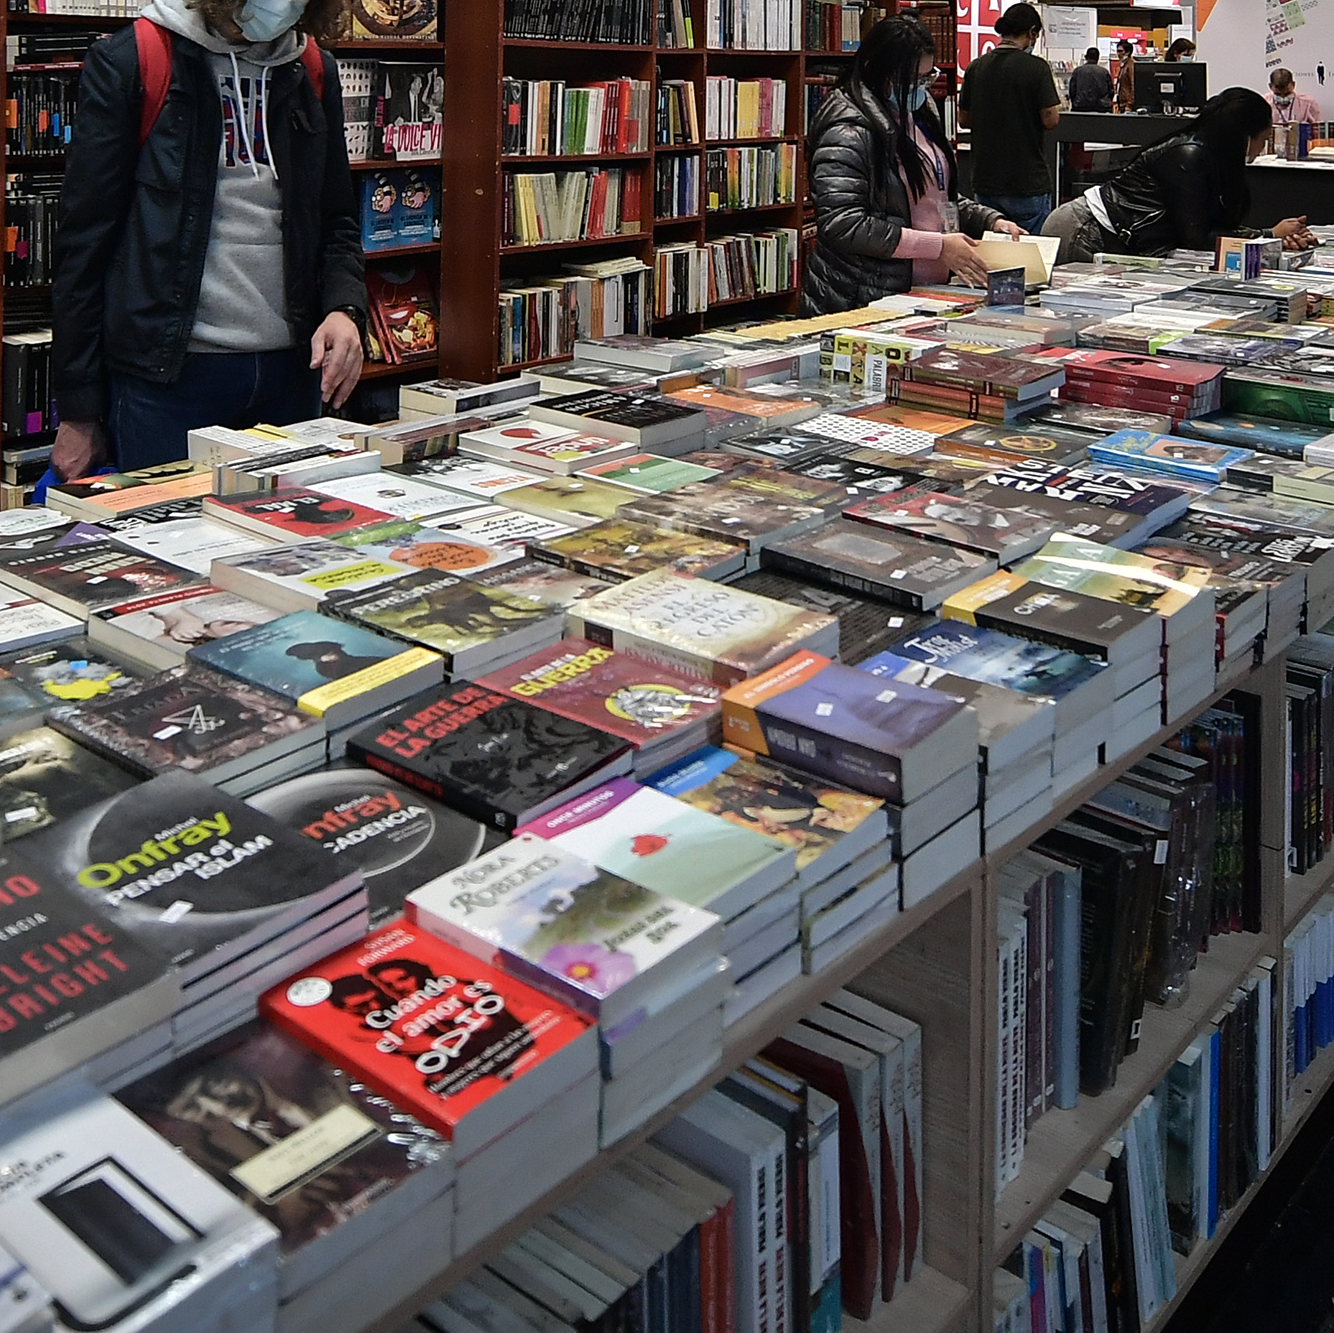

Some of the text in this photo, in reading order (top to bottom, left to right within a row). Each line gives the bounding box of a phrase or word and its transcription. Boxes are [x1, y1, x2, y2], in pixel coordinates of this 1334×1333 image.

[397, 123, 425, 153] DOLCE
[509, 647, 615, 696] GUERRA
[375, 728, 410, 748] EL
[403, 699, 459, 733] ARTE
[394, 693, 510, 759] LA GUERRA
[300, 790, 402, 840] nfray
[76, 810, 233, 890] Onfray
[104, 838, 235, 906] PENSAR el
[193, 834, 274, 881] ISLAM
[365, 974, 457, 1029] Cuando
[375, 979, 493, 1053] el amor es
[415, 994, 505, 1074] ODIO
